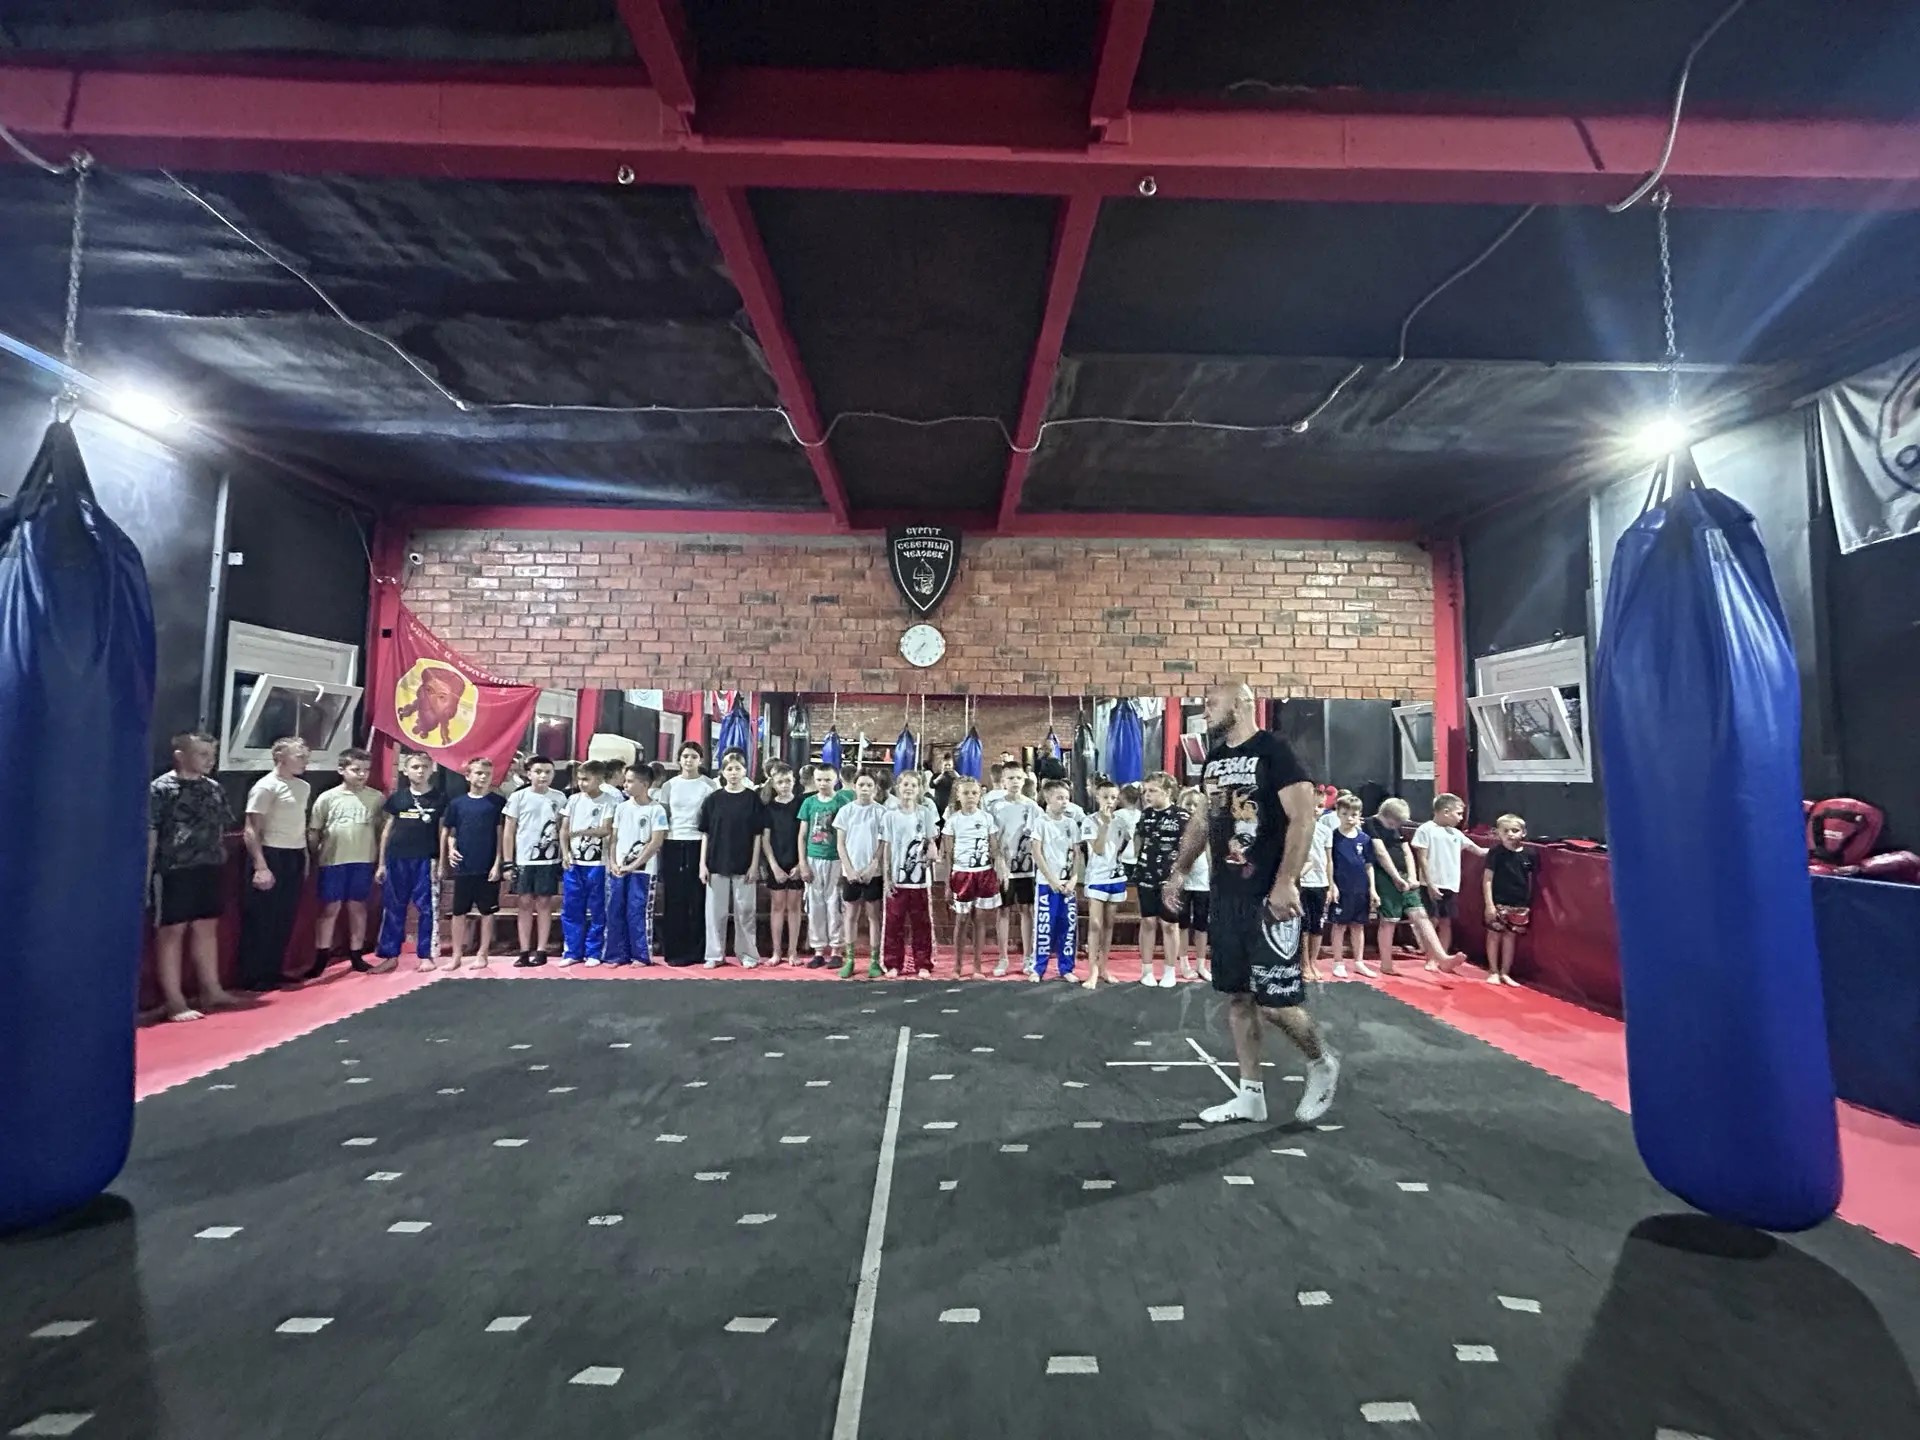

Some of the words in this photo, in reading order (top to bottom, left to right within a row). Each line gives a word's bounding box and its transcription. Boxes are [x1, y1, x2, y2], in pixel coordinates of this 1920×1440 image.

[906, 527, 942, 536] СУРГУТ
[897, 540, 950, 552] СЕВЕРНЫЙ
[903, 550, 944, 559] ЧЕЛОВЕК
[1038, 893, 1051, 956] RUSSIA
